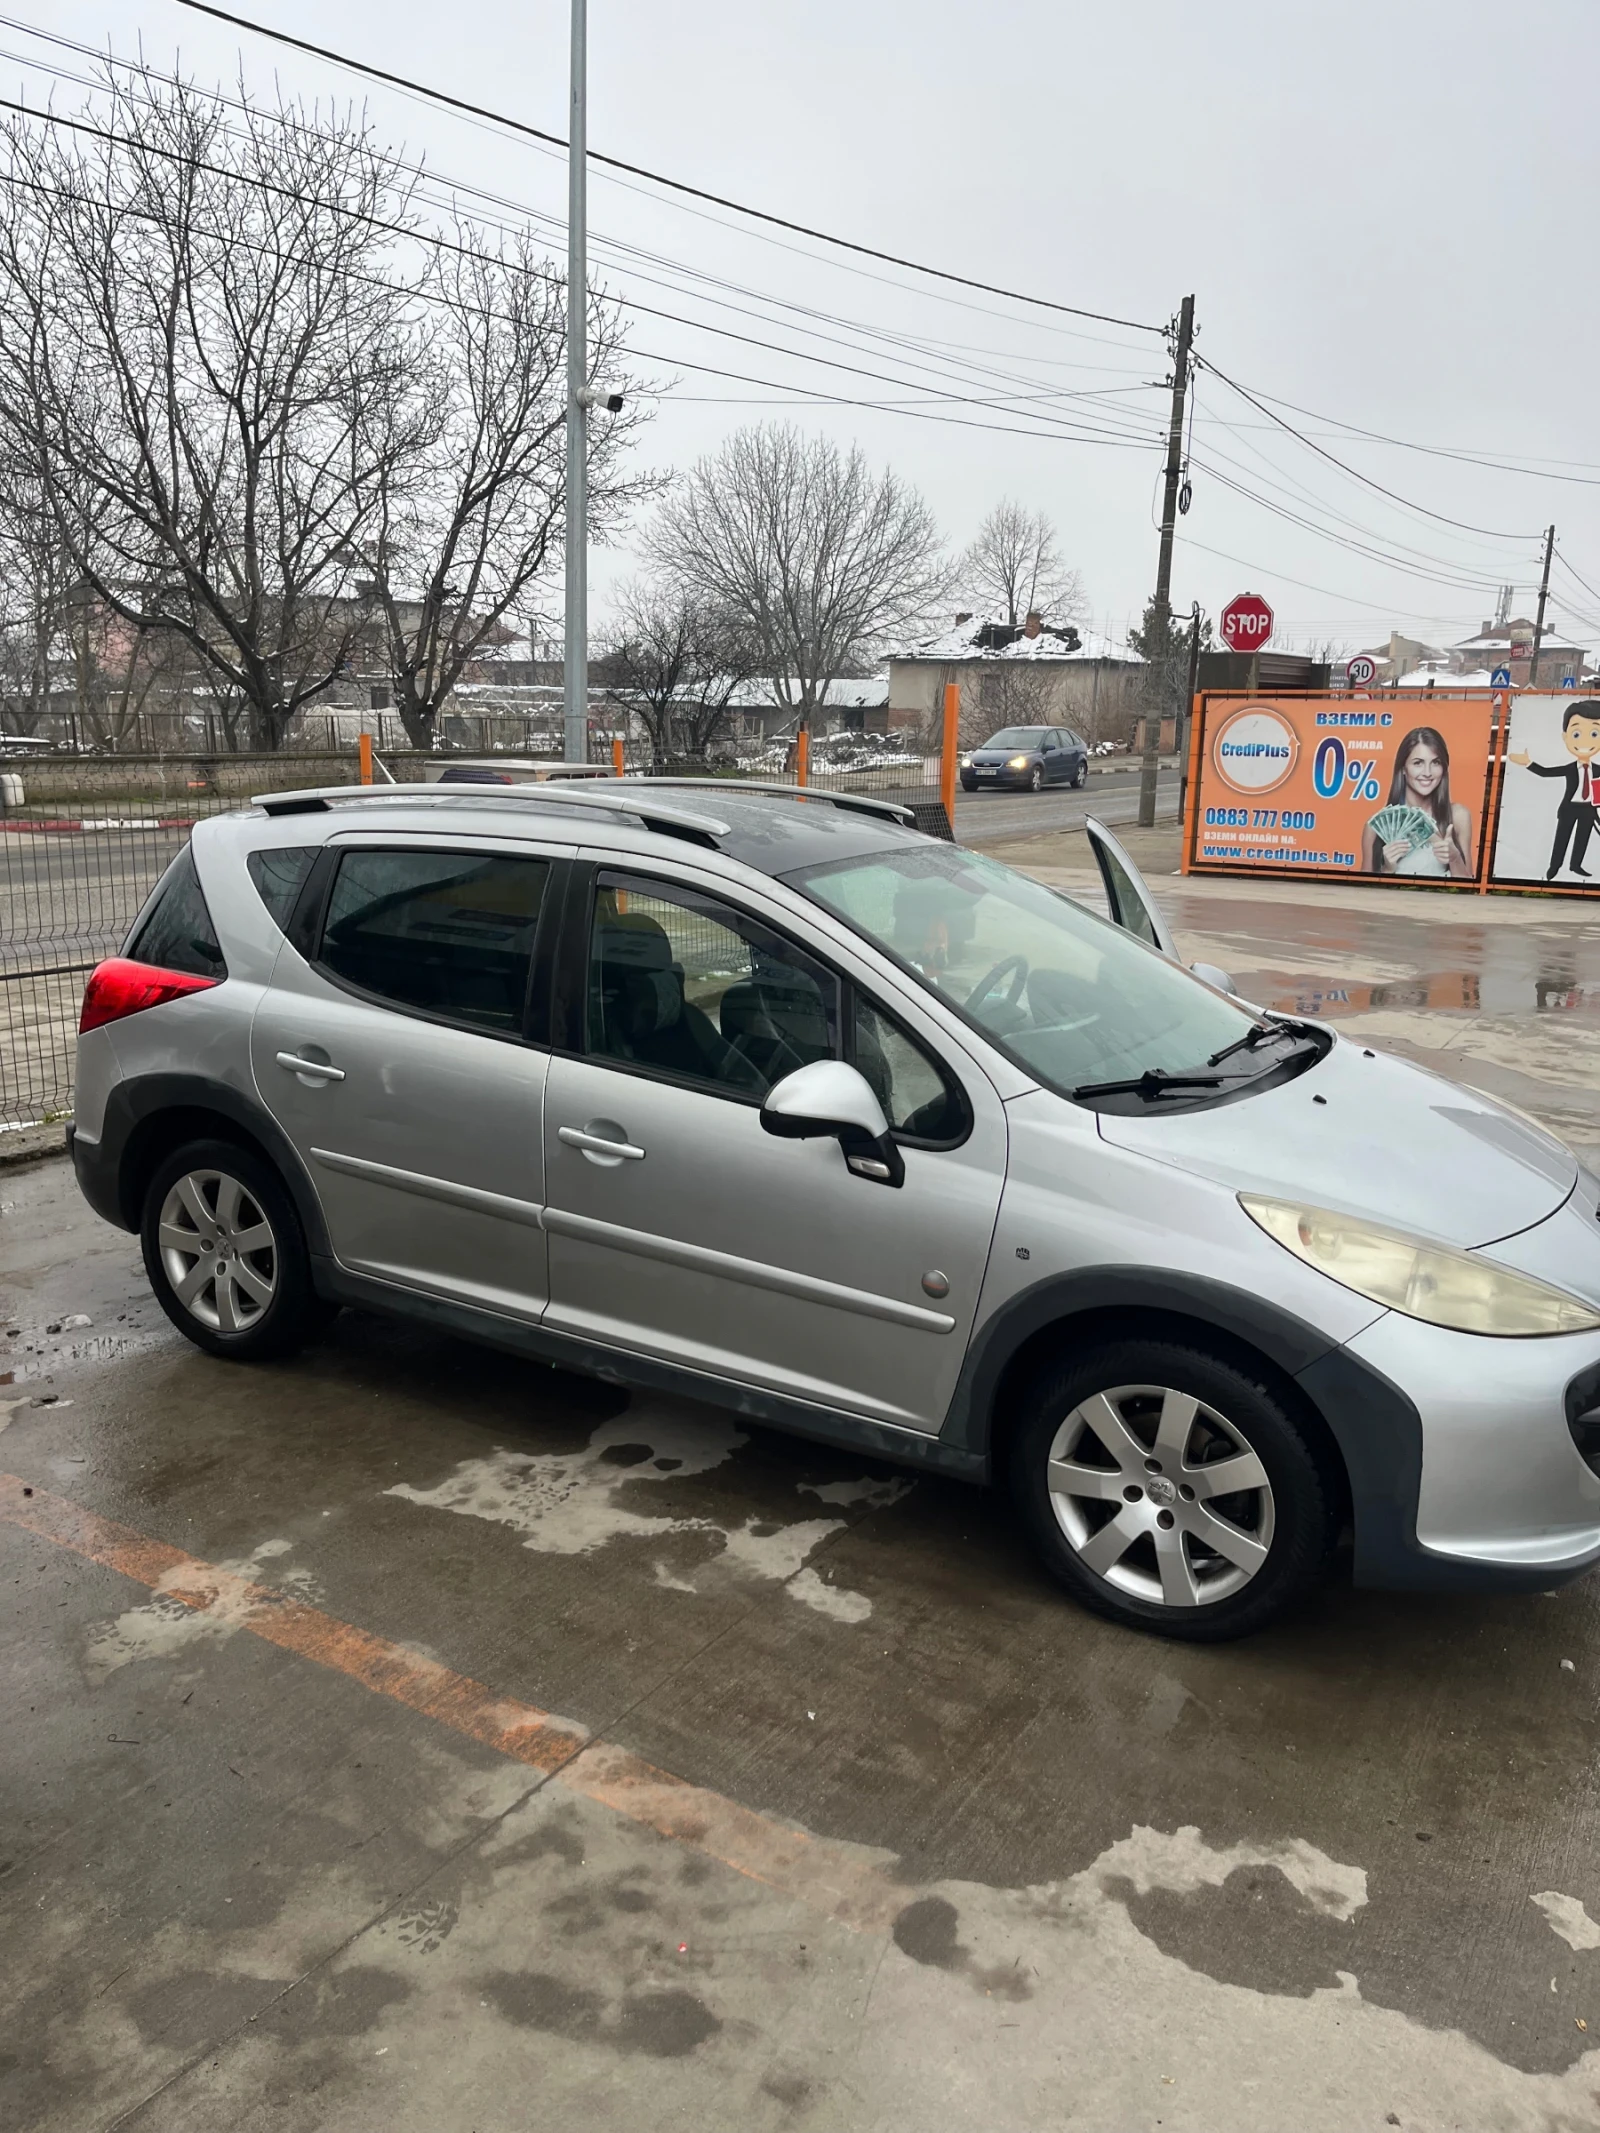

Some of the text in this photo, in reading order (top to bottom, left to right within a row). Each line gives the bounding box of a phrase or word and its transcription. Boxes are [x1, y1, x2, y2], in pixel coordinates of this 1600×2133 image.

[1225, 614, 1269, 634] STOP
[1353, 664, 1370, 678] 30
[1315, 712, 1393, 726] ВЗЕМИ С
[1221, 742, 1290, 758] CrediPlus
[1348, 740, 1384, 750] ЛИХВА
[1313, 736, 1380, 800] 0%
[1205, 807, 1316, 830] 0883 777 900
[1203, 831, 1297, 845] ВЗЕМИ ОНЛАЙН НА:
[1203, 845, 1356, 866] www.crediplus.bg
